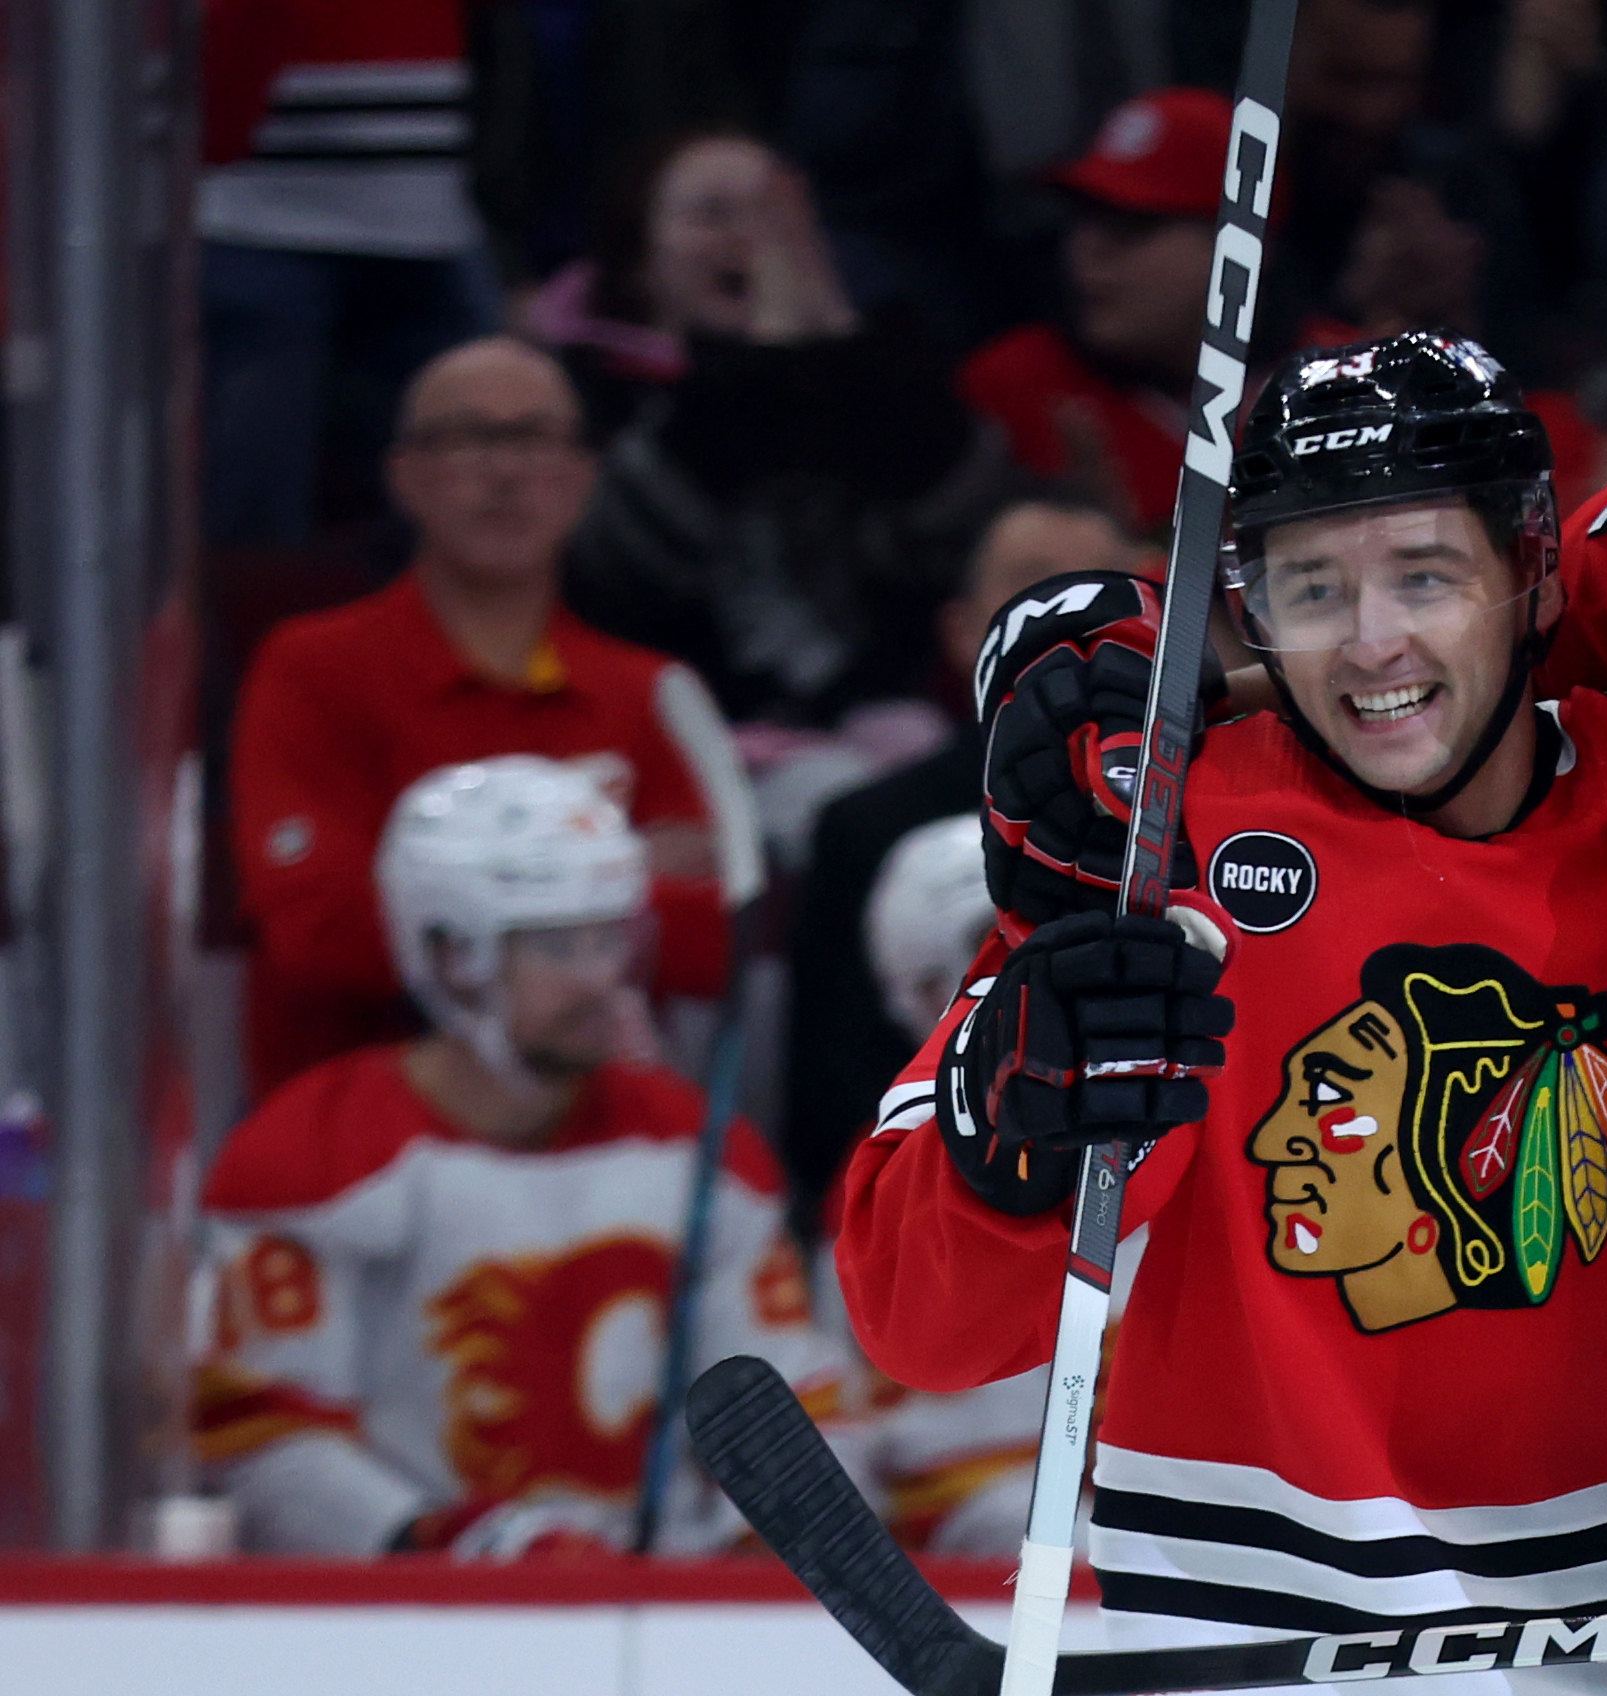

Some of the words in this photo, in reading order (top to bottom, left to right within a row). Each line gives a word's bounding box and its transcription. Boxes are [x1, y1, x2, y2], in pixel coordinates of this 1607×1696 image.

[1185, 97, 1280, 487] CCM
[1293, 423, 1395, 456] CCM
[1221, 861, 1303, 895] ROCKY
